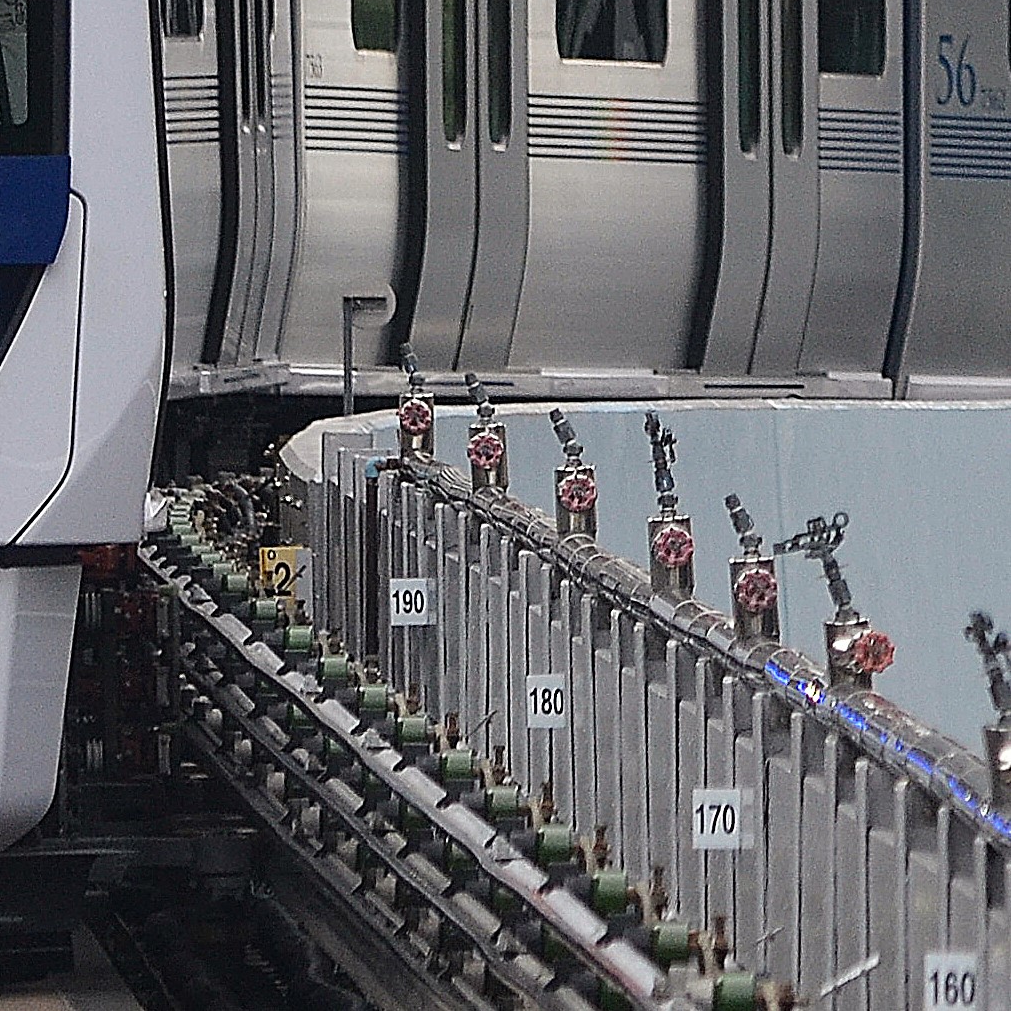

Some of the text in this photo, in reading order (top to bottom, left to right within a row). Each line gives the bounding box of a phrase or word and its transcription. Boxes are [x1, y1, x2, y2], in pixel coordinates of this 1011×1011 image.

[936, 34, 977, 105] 56
[392, 589, 425, 615] 190
[529, 687, 564, 715] 180
[695, 803, 736, 835] 170
[930, 970, 975, 1005] 160
